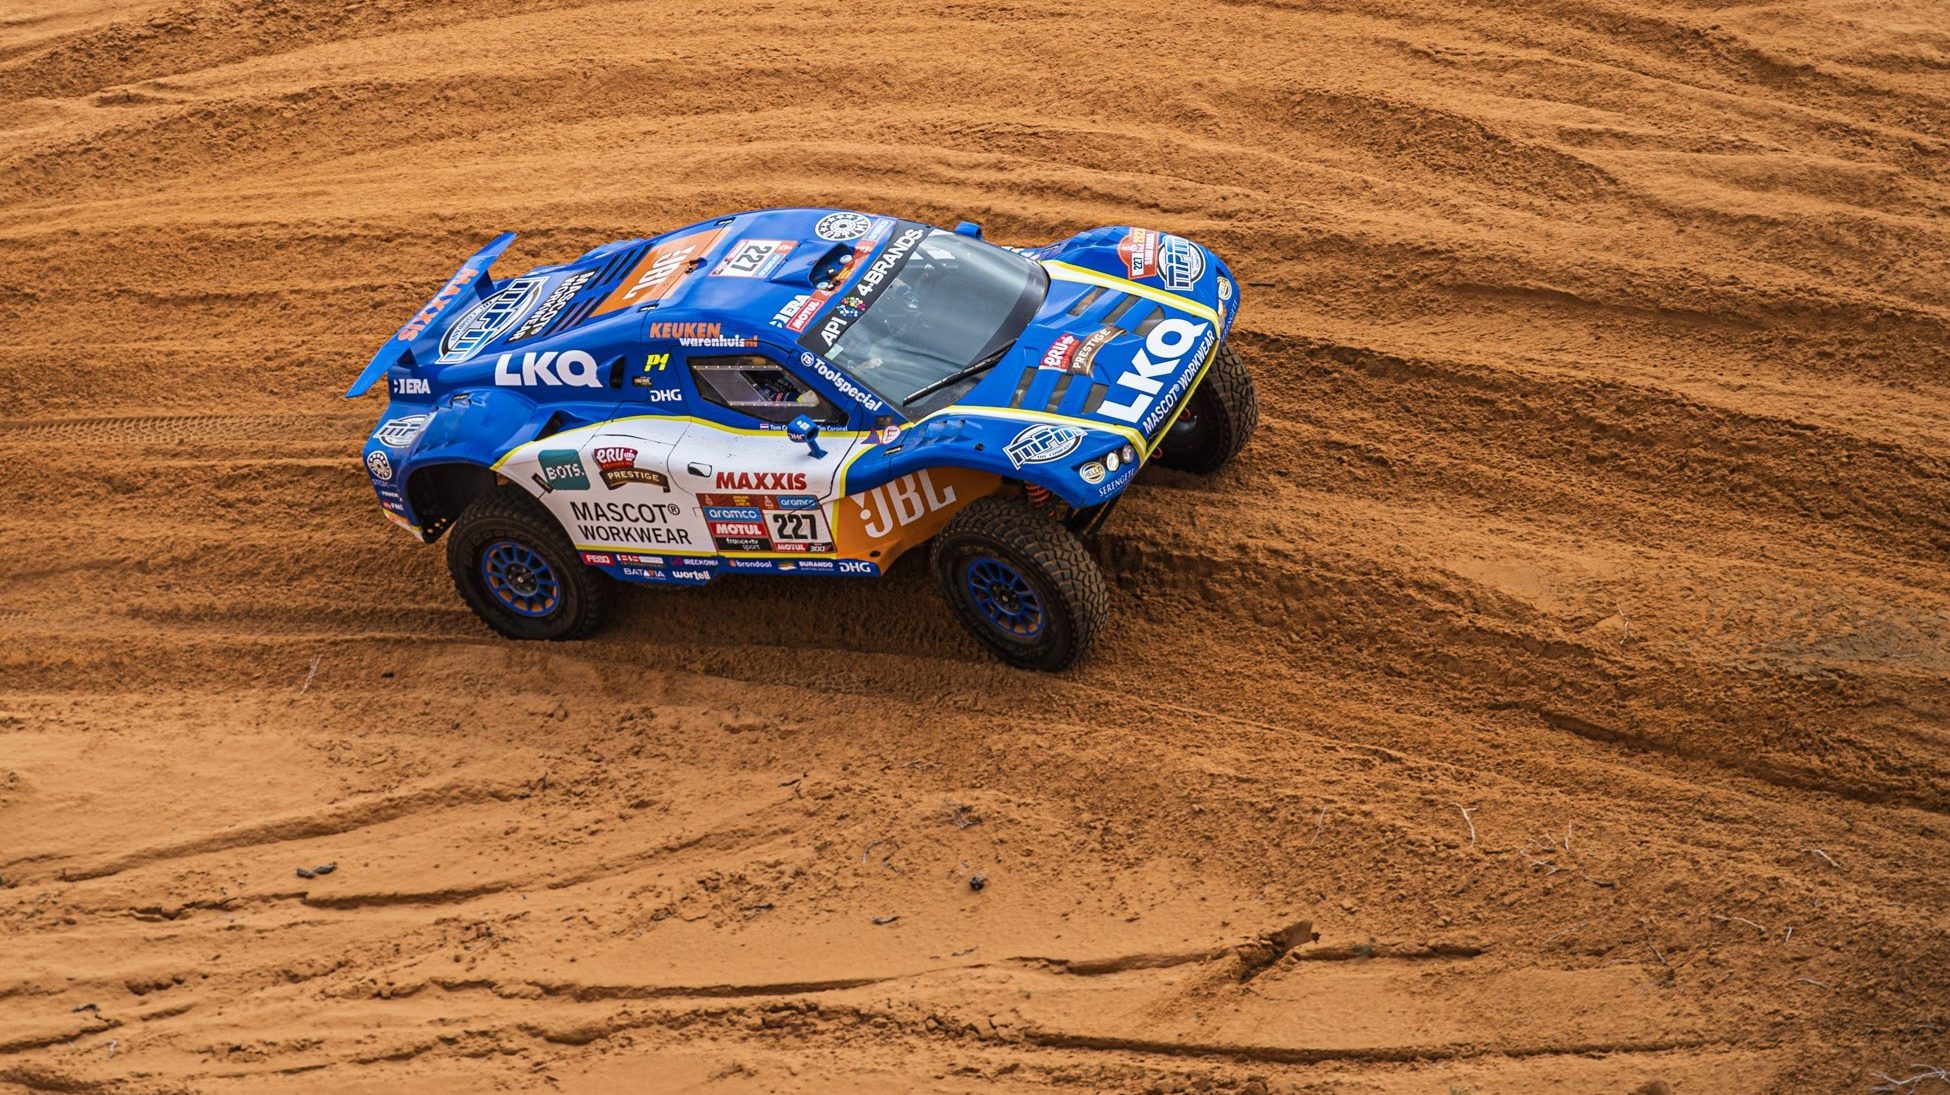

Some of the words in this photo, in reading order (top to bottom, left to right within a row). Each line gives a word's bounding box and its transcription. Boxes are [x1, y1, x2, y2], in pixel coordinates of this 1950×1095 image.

[731, 246, 772, 271] 227
[1133, 257, 1143, 270] 227
[623, 250, 682, 300] JBL
[820, 317, 847, 346] API
[857, 229, 923, 296] 4.BRANDS.
[398, 268, 480, 341] MAXXIS
[509, 275, 578, 341] WORKWEAR
[791, 301, 820, 329] MOTUL
[649, 322, 721, 338] KEUKEN
[1072, 328, 1111, 369] PRESTIGE
[1177, 329, 1215, 390] WORKWEAR
[494, 350, 603, 389] LKQ
[1096, 318, 1208, 423] LKQ
[650, 389, 682, 402] DHG
[814, 358, 883, 411] Toolspecial
[607, 470, 661, 482] PRESTIGE
[716, 472, 807, 490] MAXXIS
[709, 509, 757, 519] aramco
[864, 469, 957, 538] JBL
[578, 525, 693, 545] WORKWEAR
[716, 524, 761, 535] MOTUL
[772, 514, 818, 540] 227
[672, 570, 711, 580] wortell
[839, 562, 871, 573] DHG
